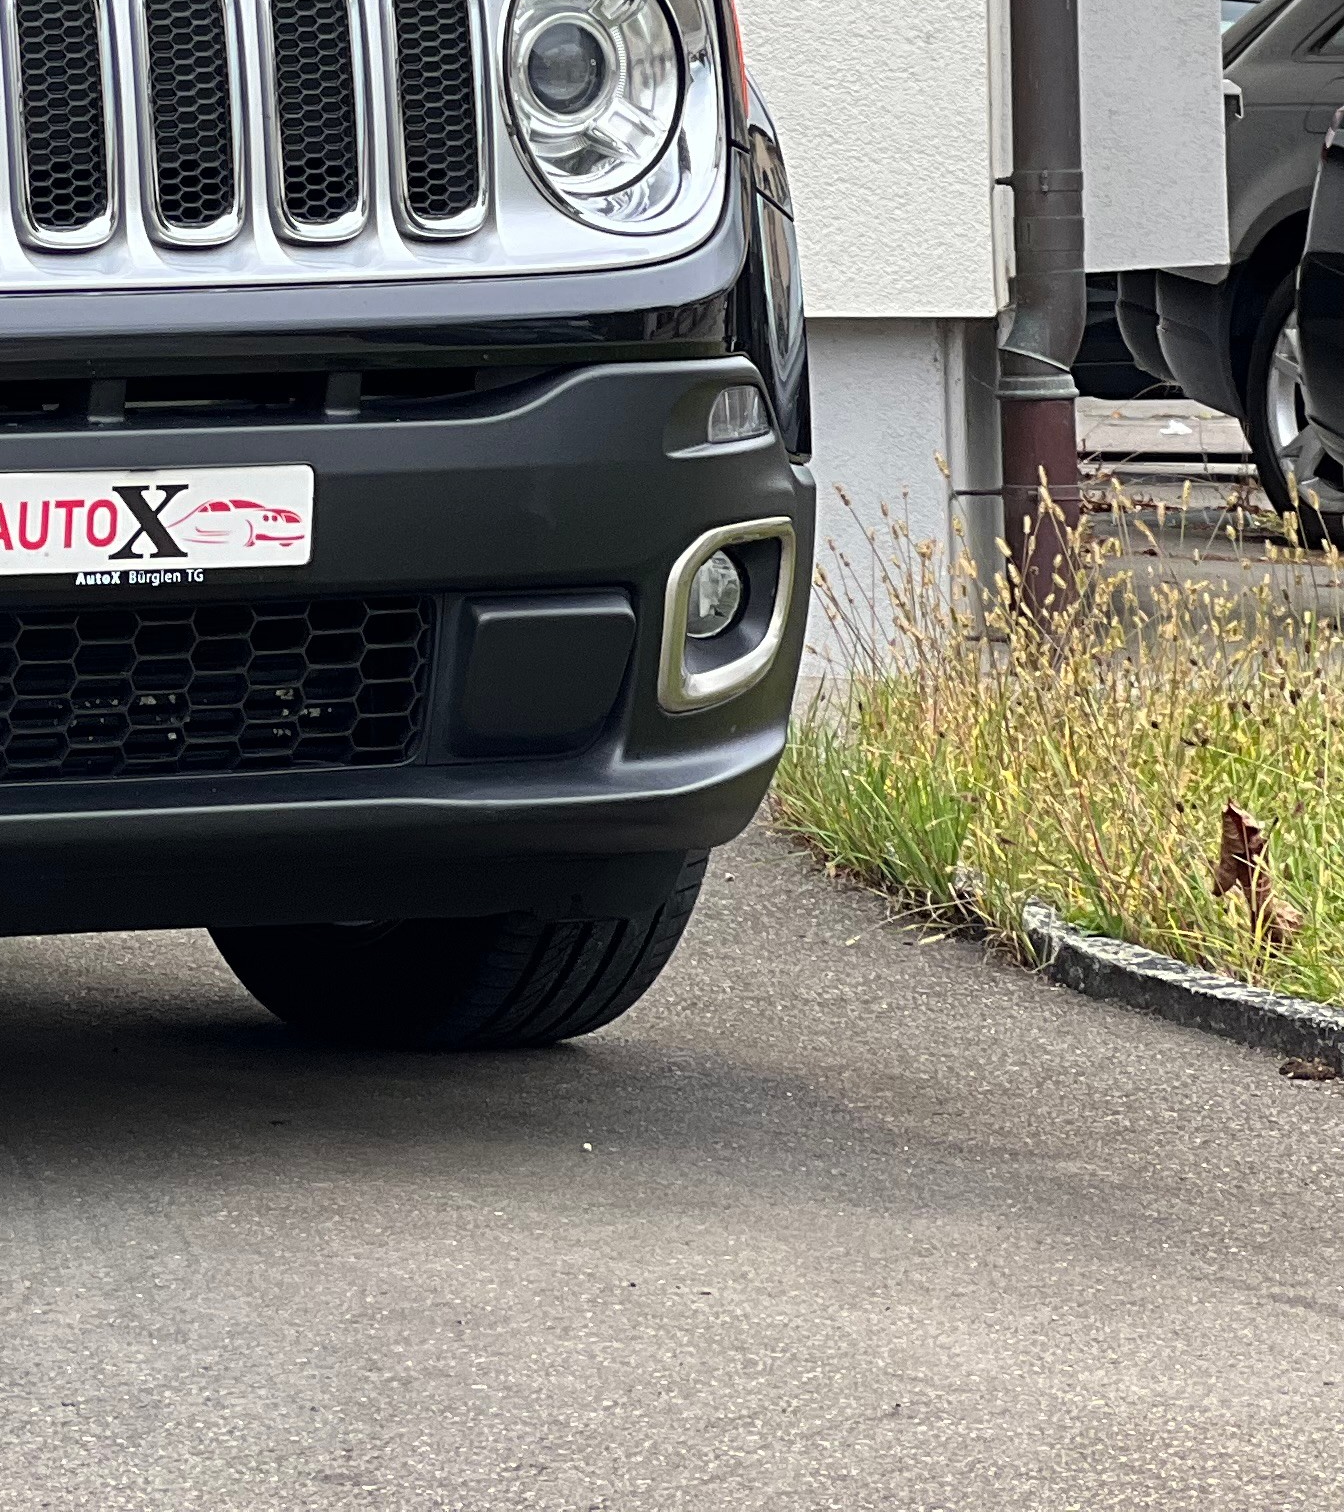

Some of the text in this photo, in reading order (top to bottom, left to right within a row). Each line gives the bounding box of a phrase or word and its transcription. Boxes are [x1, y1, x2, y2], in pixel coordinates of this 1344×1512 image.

[75, 568, 204, 586] AutoX Bürglen TG
